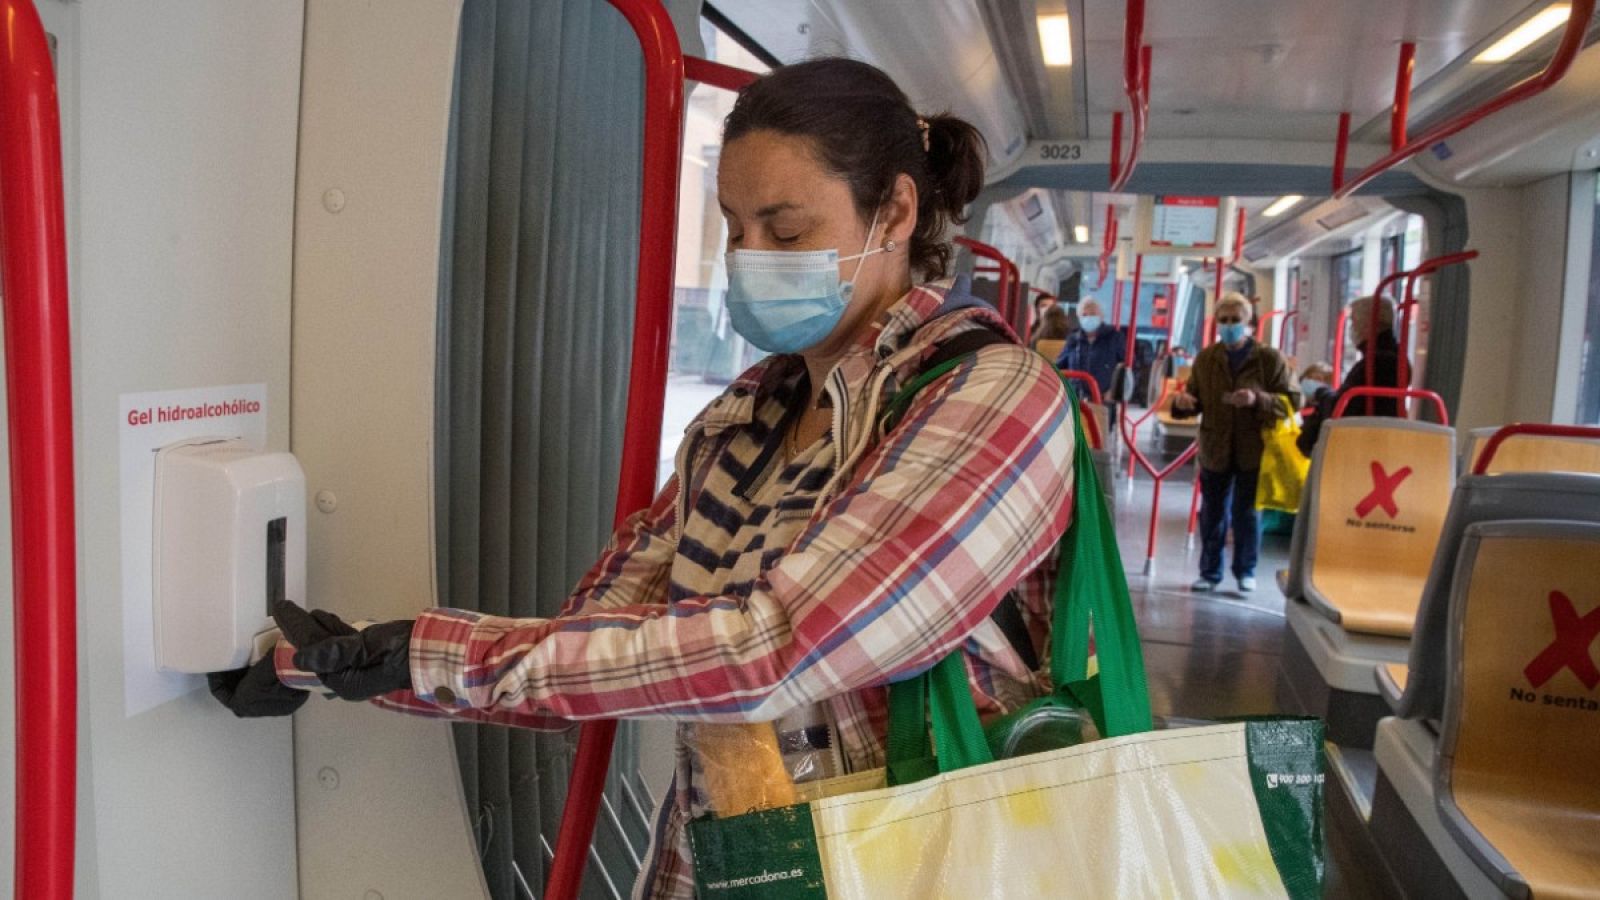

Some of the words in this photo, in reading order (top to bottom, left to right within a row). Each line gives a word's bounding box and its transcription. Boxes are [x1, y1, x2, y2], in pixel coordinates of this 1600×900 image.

[1040, 144, 1081, 160] 3023
[128, 407, 153, 425] Gel
[158, 399, 260, 423] hidroalcohólico
[1346, 518, 1362, 527] No
[1365, 522, 1416, 533] sentarse
[1510, 688, 1537, 703] No
[706, 868, 803, 889] www.mercadona.es
